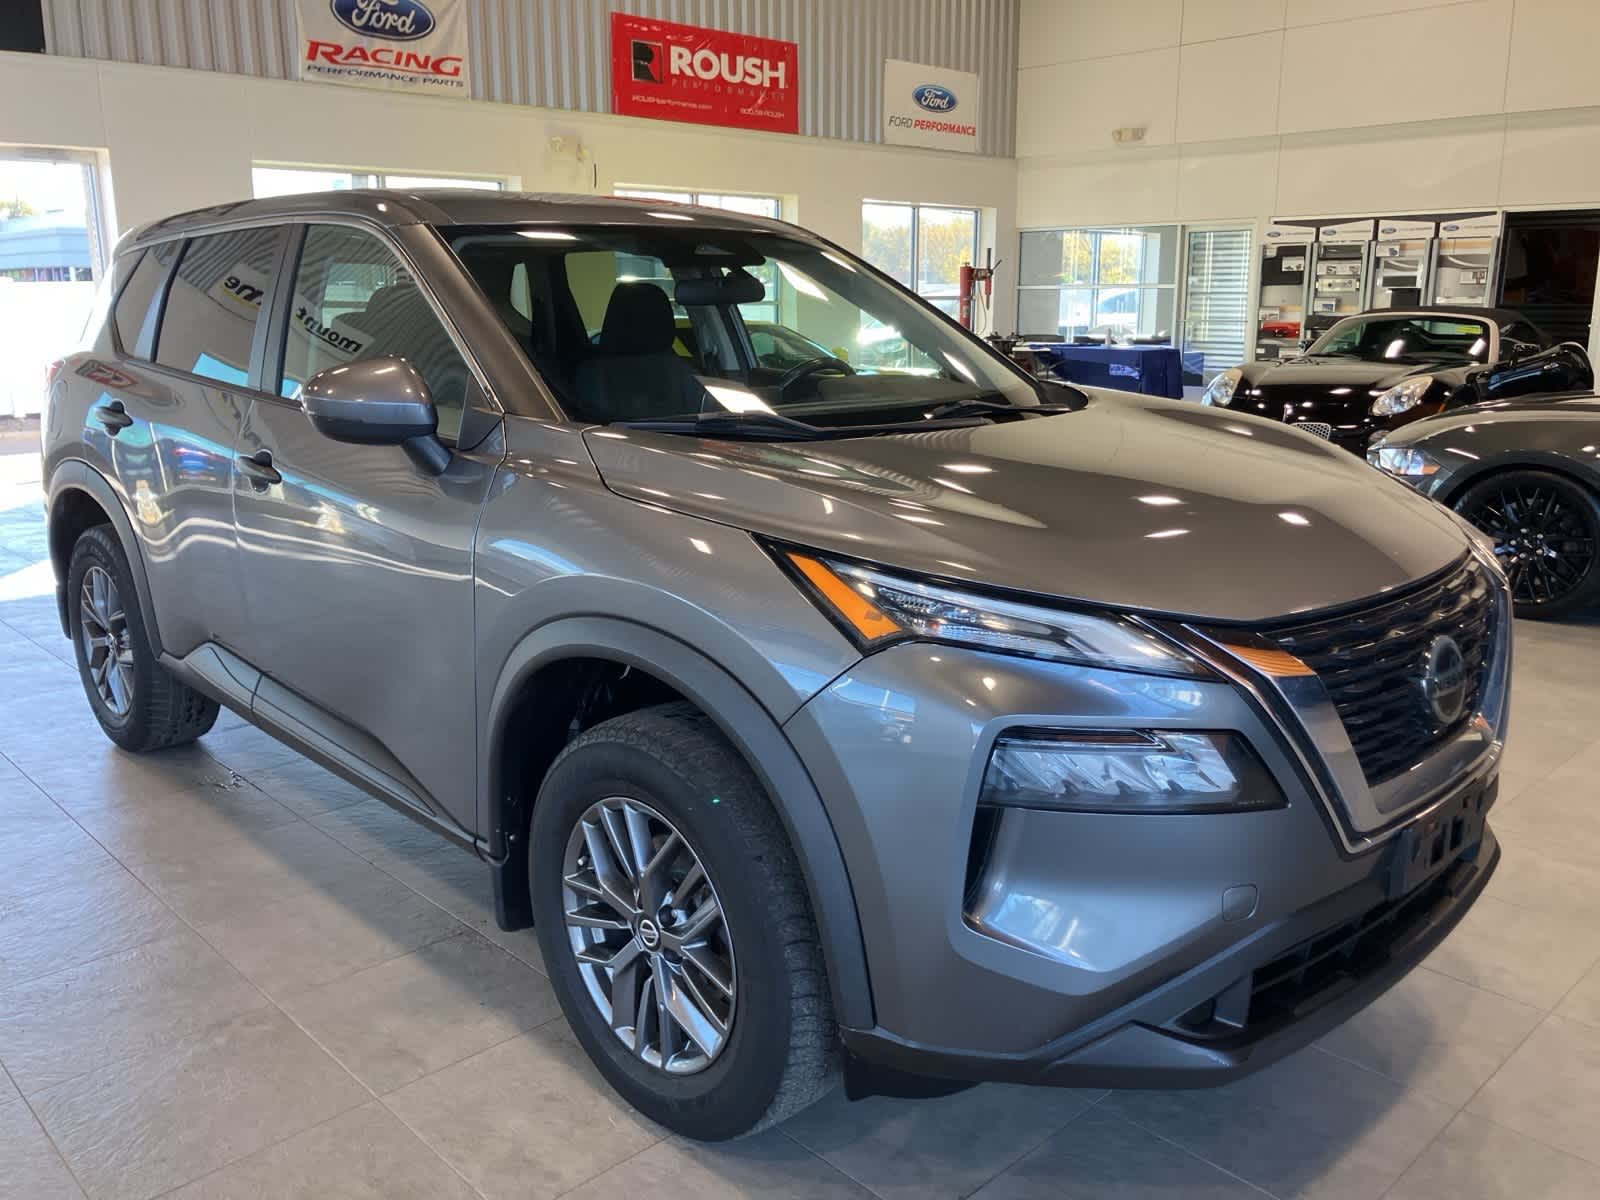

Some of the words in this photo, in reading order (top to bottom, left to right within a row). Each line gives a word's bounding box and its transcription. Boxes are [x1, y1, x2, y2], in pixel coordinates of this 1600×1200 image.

[351, 0, 416, 34] Ford
[306, 40, 463, 77] RACING
[670, 44, 786, 88] ROUSH
[306, 65, 418, 84] PERFORMANCE
[422, 77, 464, 88] PARTS
[921, 88, 950, 109] Ford
[888, 115, 913, 129] FORD
[913, 119, 977, 137] PERFORMANCE
